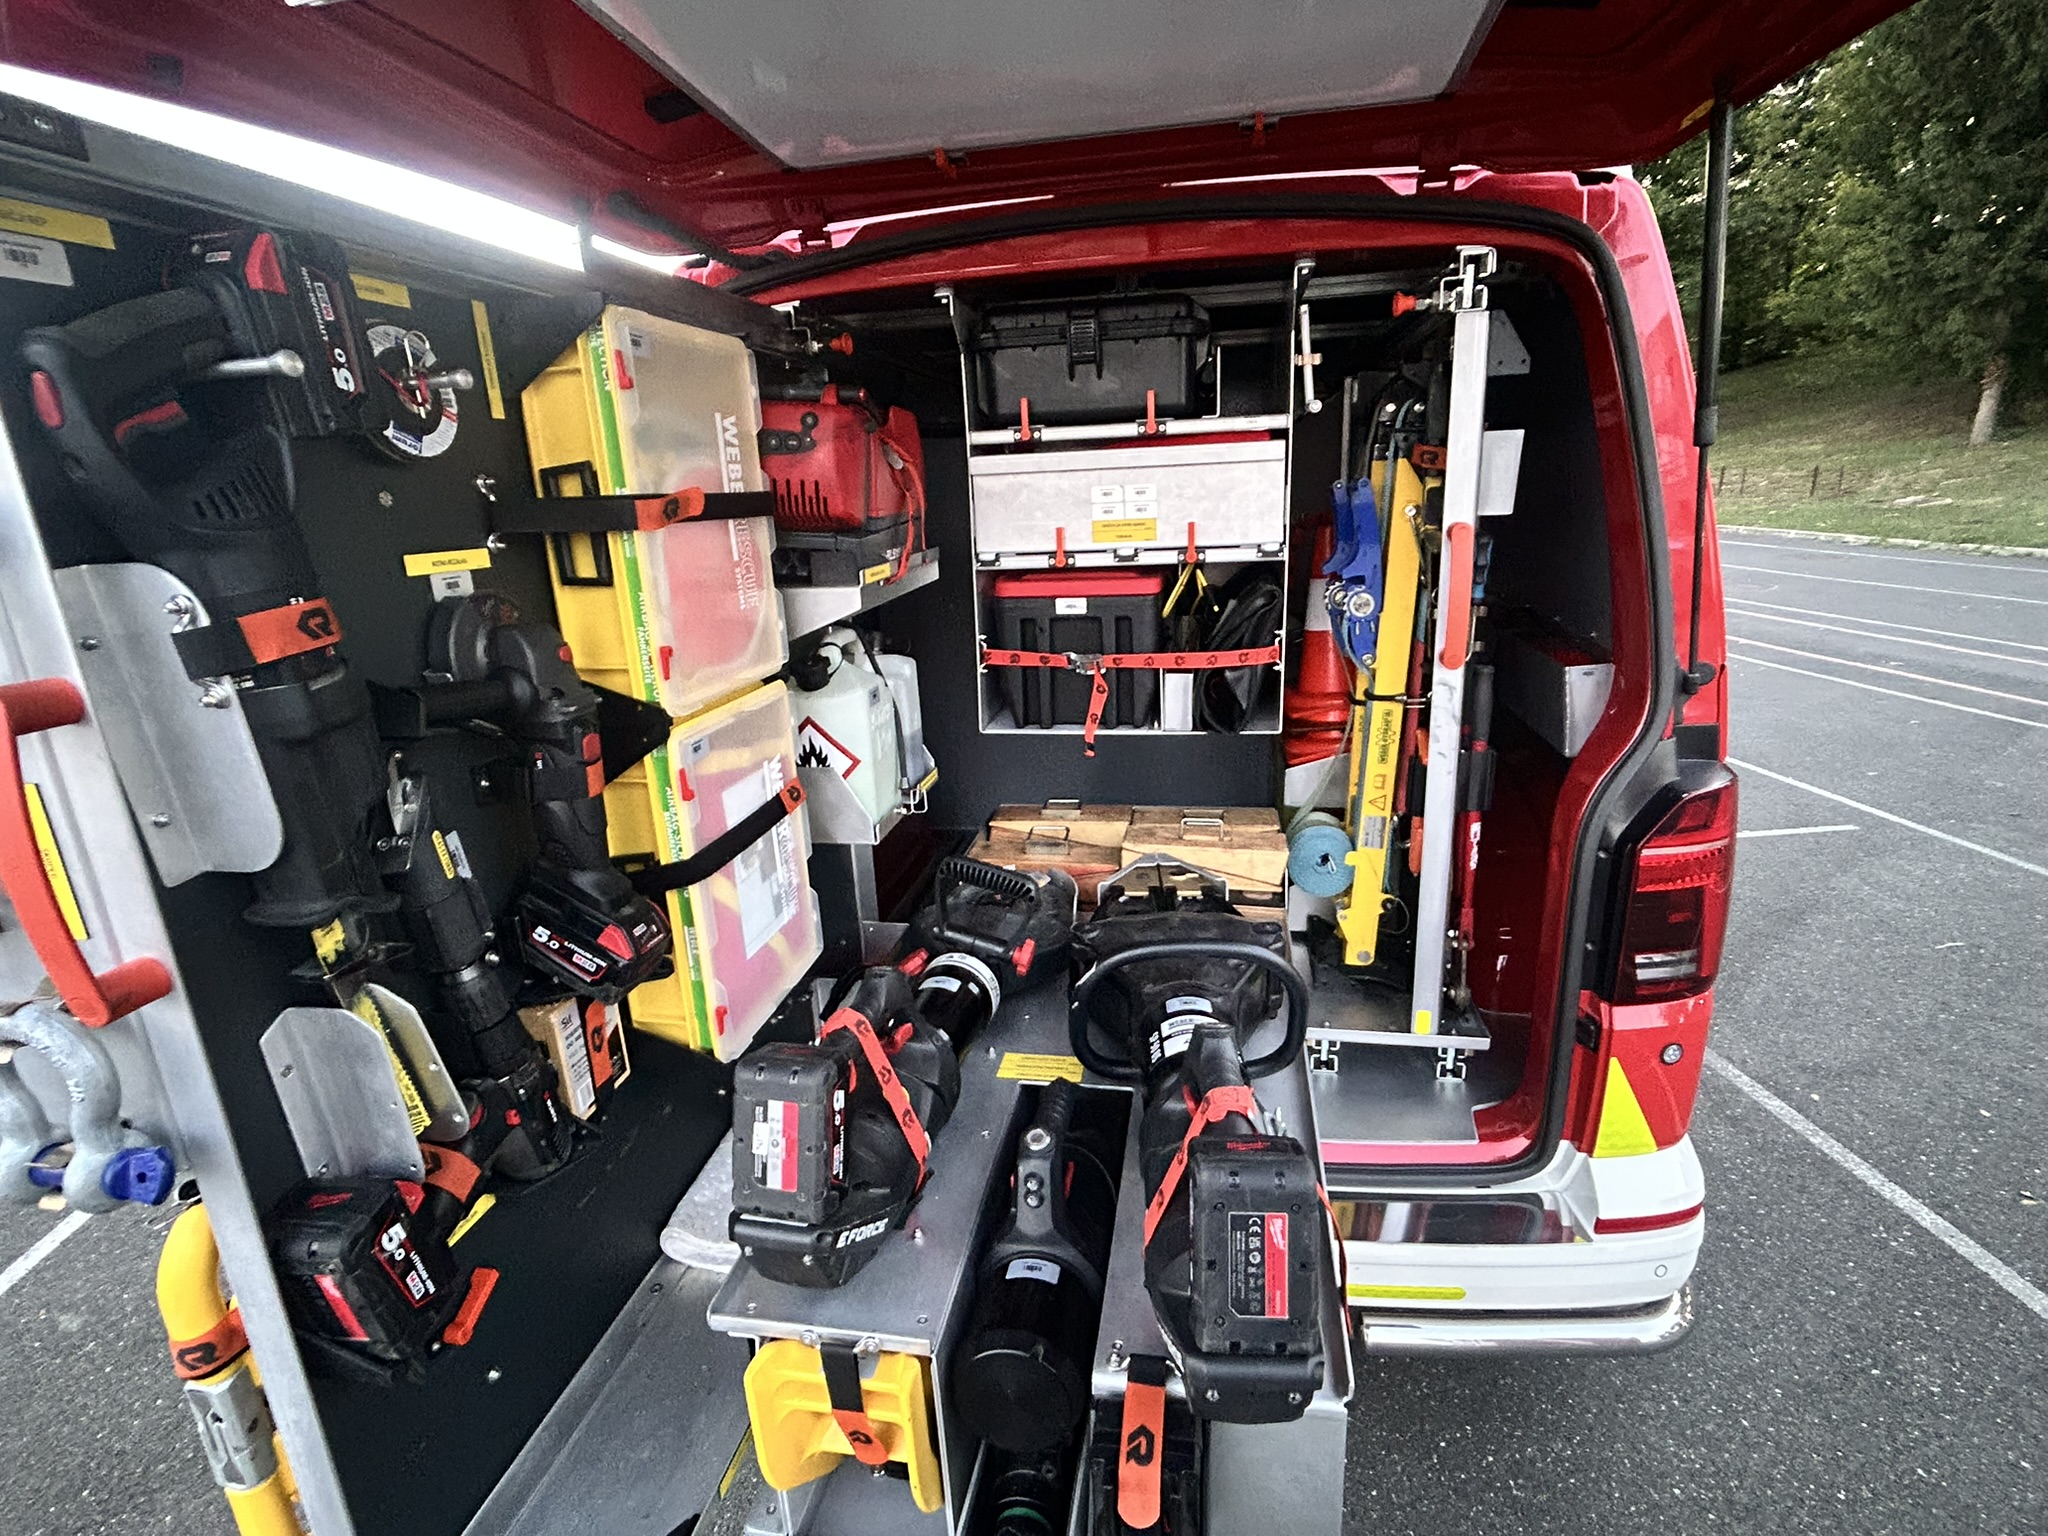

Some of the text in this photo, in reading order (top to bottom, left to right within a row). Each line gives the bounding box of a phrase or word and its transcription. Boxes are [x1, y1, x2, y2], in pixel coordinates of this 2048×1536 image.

[331, 347, 356, 393] 5.0
[722, 415, 745, 494] WEBE
[532, 925, 560, 950] 5.0
[564, 941, 608, 968] LITHIUM-ION
[833, 1089, 845, 1126] 5.0
[381, 1222, 407, 1261] 5.0
[409, 1250, 437, 1295] LITHIUM-ION
